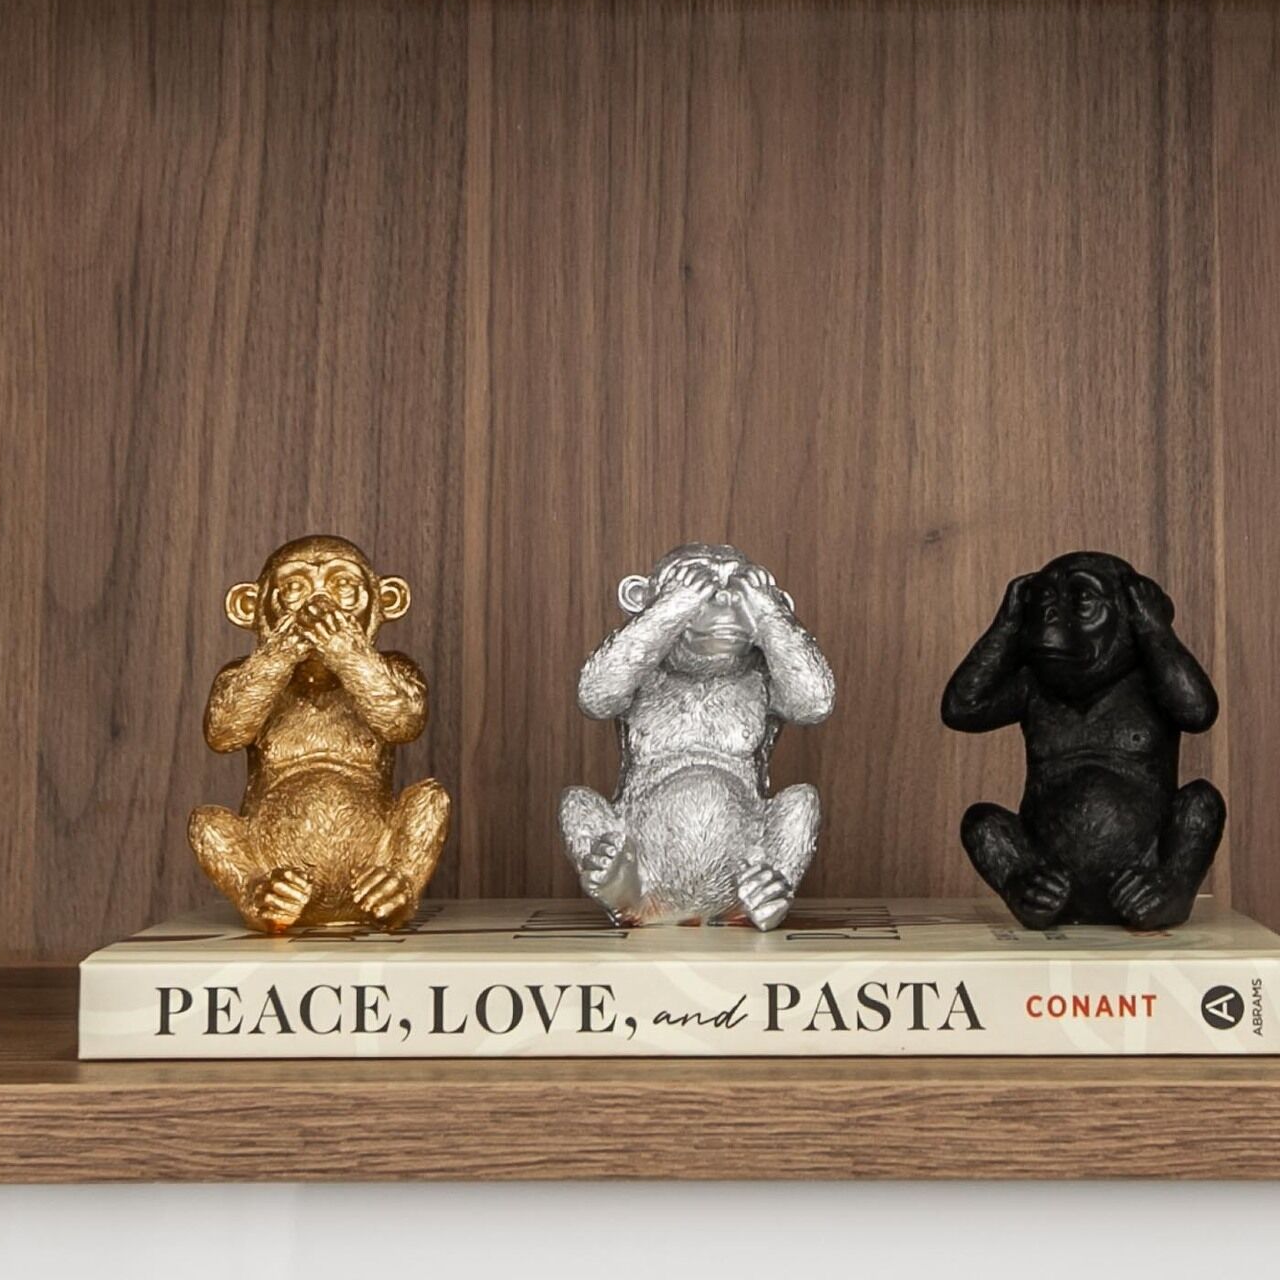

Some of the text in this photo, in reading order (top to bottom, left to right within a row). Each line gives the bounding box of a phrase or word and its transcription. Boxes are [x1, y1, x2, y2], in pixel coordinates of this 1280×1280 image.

[154, 980, 987, 1042] PEACE, LOVE, and PASTA
[1025, 994, 1158, 1018] CONANT
[1251, 977, 1264, 1038] ABRAMS
